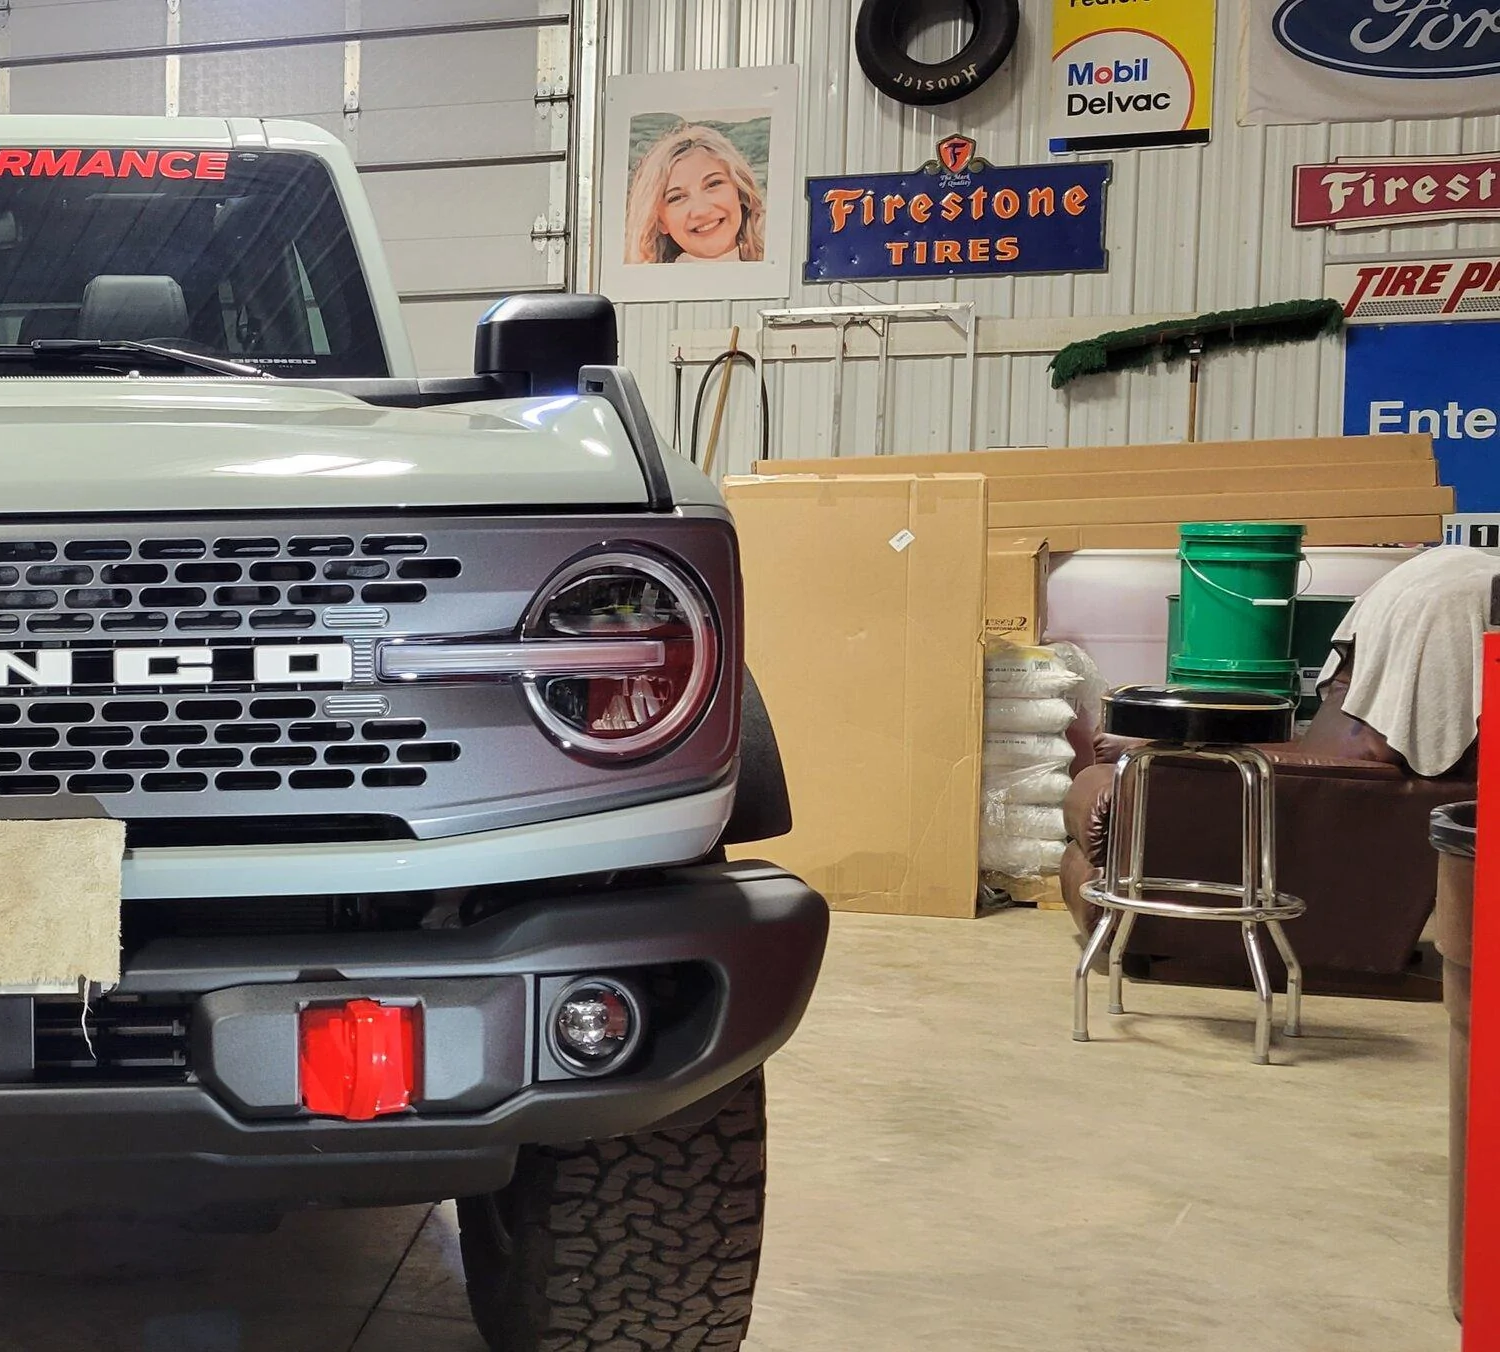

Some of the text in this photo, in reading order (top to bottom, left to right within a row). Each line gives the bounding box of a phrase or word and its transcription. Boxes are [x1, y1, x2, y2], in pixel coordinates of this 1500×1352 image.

[893, 63, 980, 91] Hoosier
[1068, 58, 1149, 86] Mobil
[1067, 91, 1171, 116] Delvac
[1321, 167, 1497, 215] Firest
[824, 184, 1089, 233] Firestone
[885, 237, 1020, 266] TIRES
[1344, 263, 1454, 318] TIRE
[1369, 400, 1498, 440] Ente
